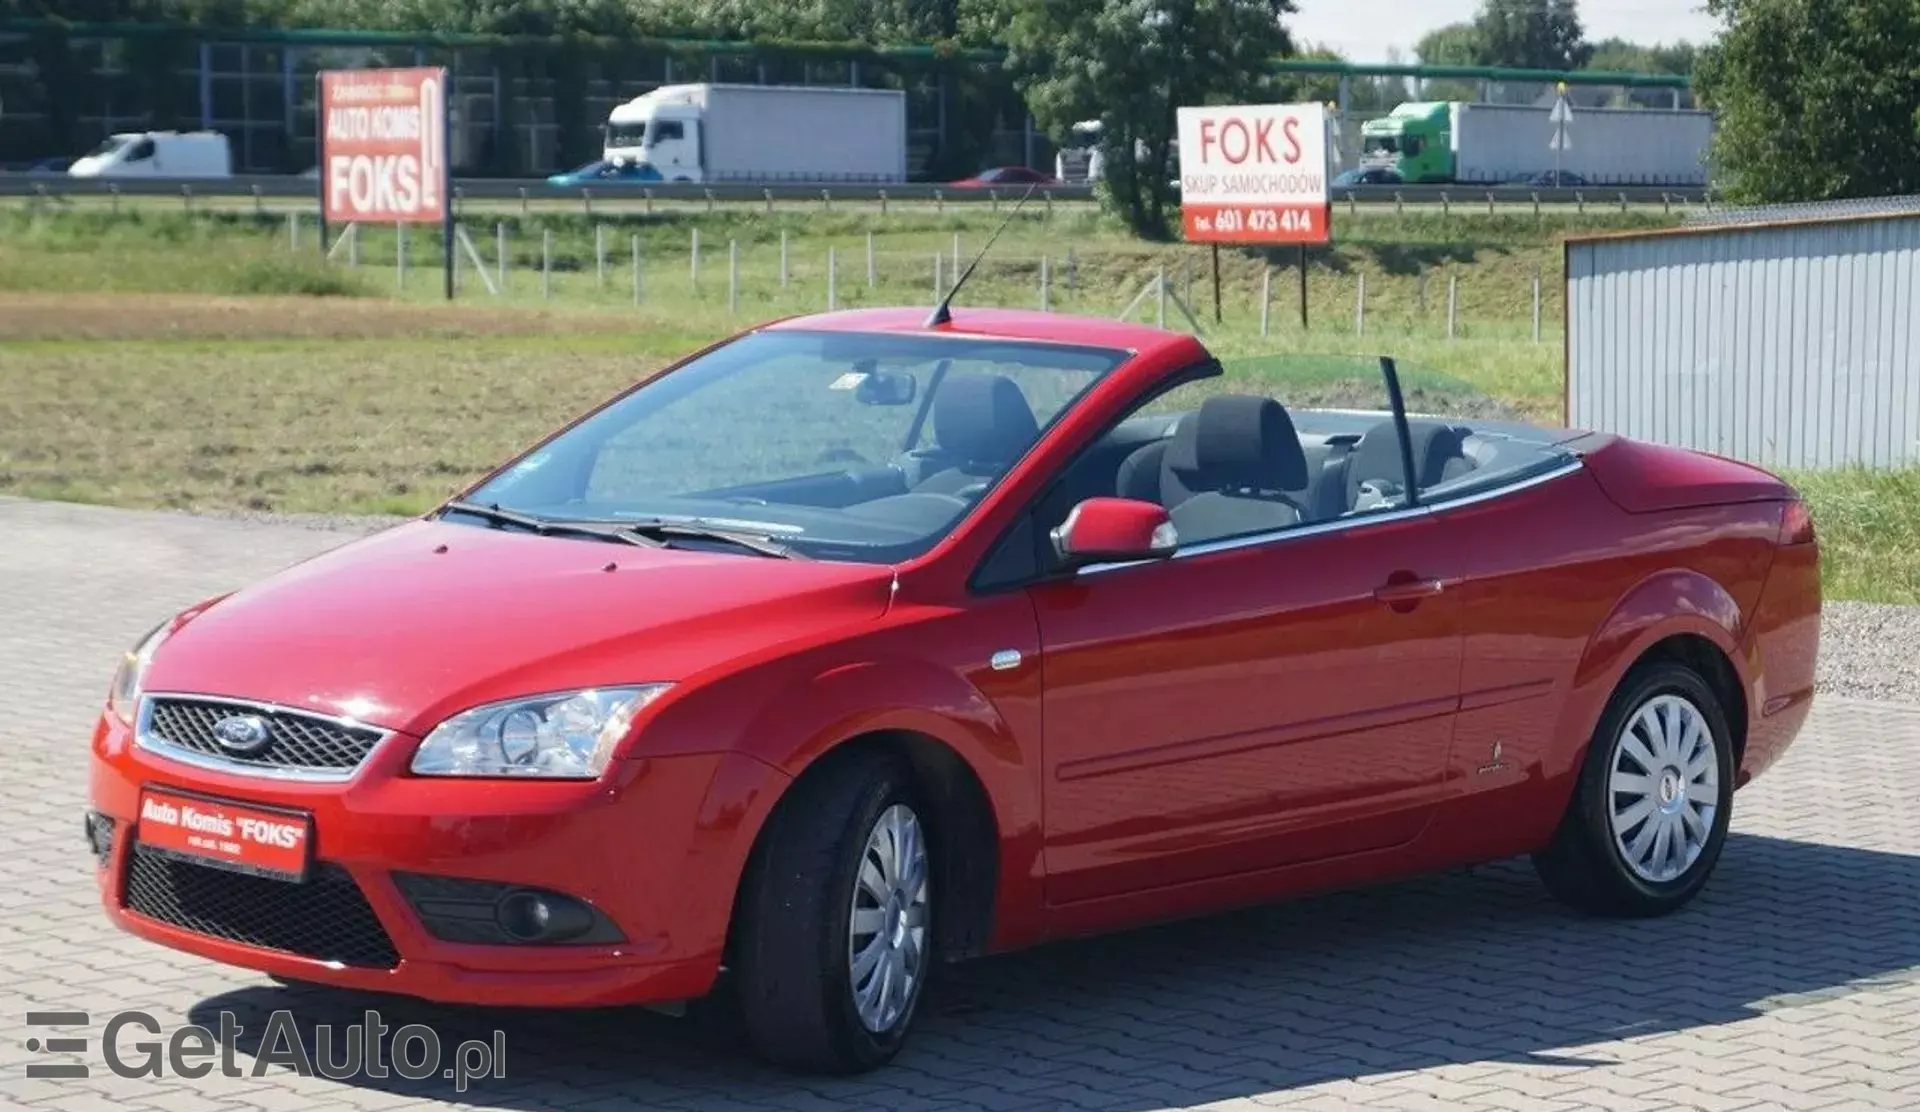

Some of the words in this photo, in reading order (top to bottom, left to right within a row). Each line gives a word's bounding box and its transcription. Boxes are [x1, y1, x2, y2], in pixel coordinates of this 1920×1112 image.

[328, 106, 370, 140] AUTO
[371, 105, 420, 139] KOMIS
[1200, 116, 1301, 165] FOKS
[330, 153, 419, 214] FOKS
[1185, 175, 1216, 194] SKUP
[1222, 168, 1321, 195] SAMOCHODÓW
[1215, 209, 1243, 232] 601
[1247, 209, 1277, 232] 473
[1280, 209, 1312, 232] 414
[142, 797, 178, 826] Auto
[181, 805, 234, 837] Komis
[235, 816, 304, 849] "FOKS"
